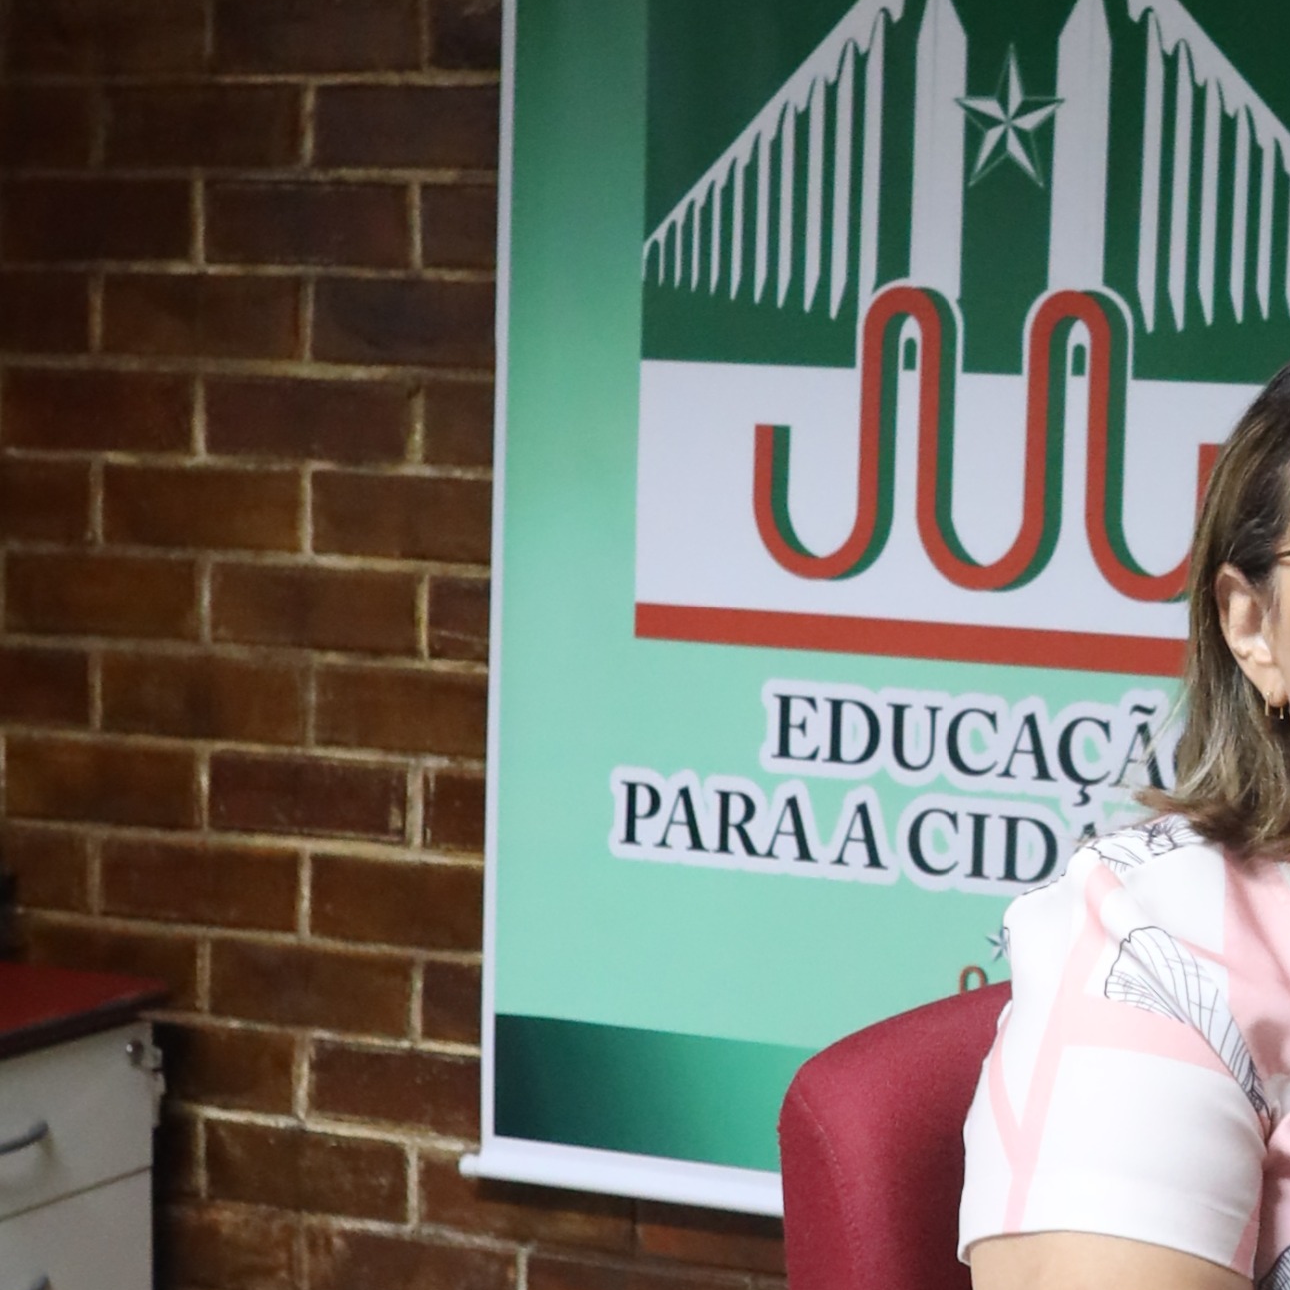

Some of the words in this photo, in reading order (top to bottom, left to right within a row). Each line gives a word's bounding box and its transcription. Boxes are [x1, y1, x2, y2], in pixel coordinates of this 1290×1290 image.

[770, 693, 1176, 807] EDUCAÇÃ
[619, 780, 817, 863] PARA
[833, 800, 888, 869] A
[907, 807, 1098, 884] CID
